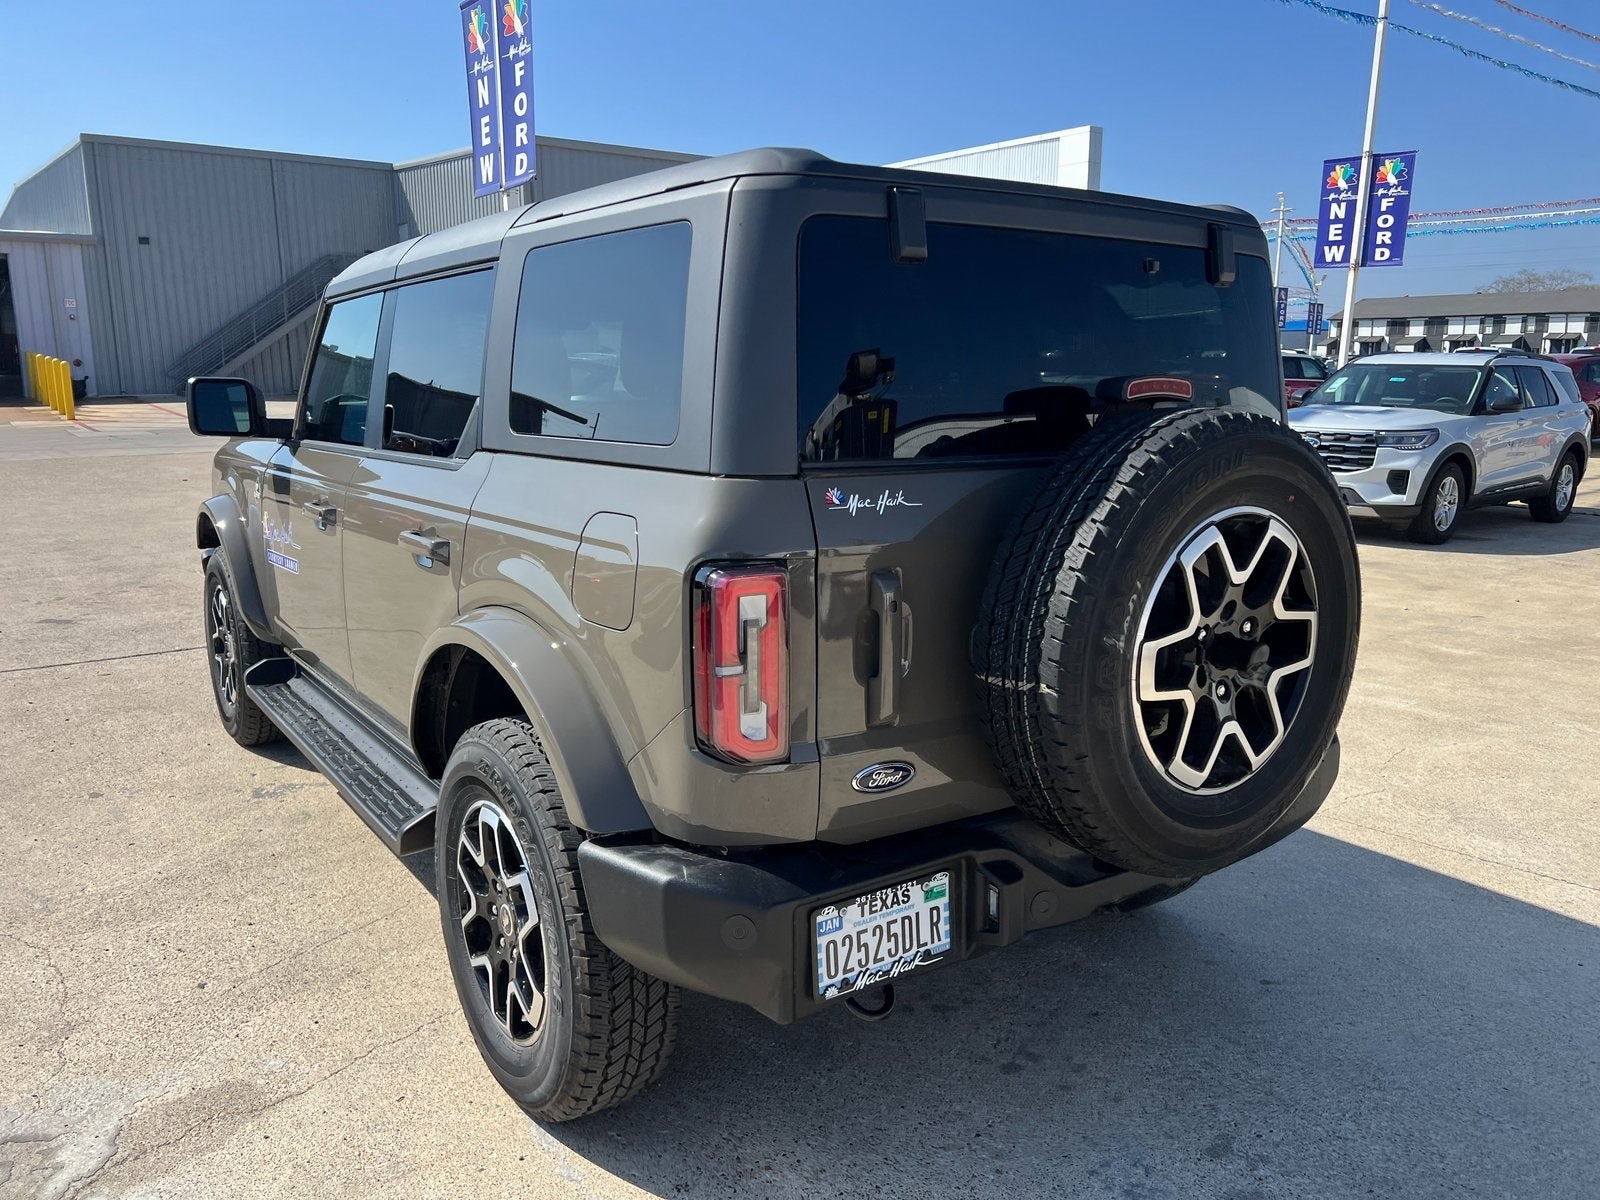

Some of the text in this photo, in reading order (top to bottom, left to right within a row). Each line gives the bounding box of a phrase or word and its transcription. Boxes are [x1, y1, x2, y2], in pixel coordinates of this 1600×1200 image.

[477, 76, 494, 185] NEW
[513, 60, 529, 177] FORD
[1323, 202, 1347, 263] NEW
[1374, 198, 1395, 261] FORD
[828, 489, 923, 517] Mac Haik
[868, 768, 903, 787] Ford
[853, 903, 915, 927] DEALER TEMPORARY
[857, 888, 911, 917] TEXAS
[820, 917, 840, 933] JAN
[825, 905, 942, 980] 02525DLR
[889, 951, 944, 978] Haik
